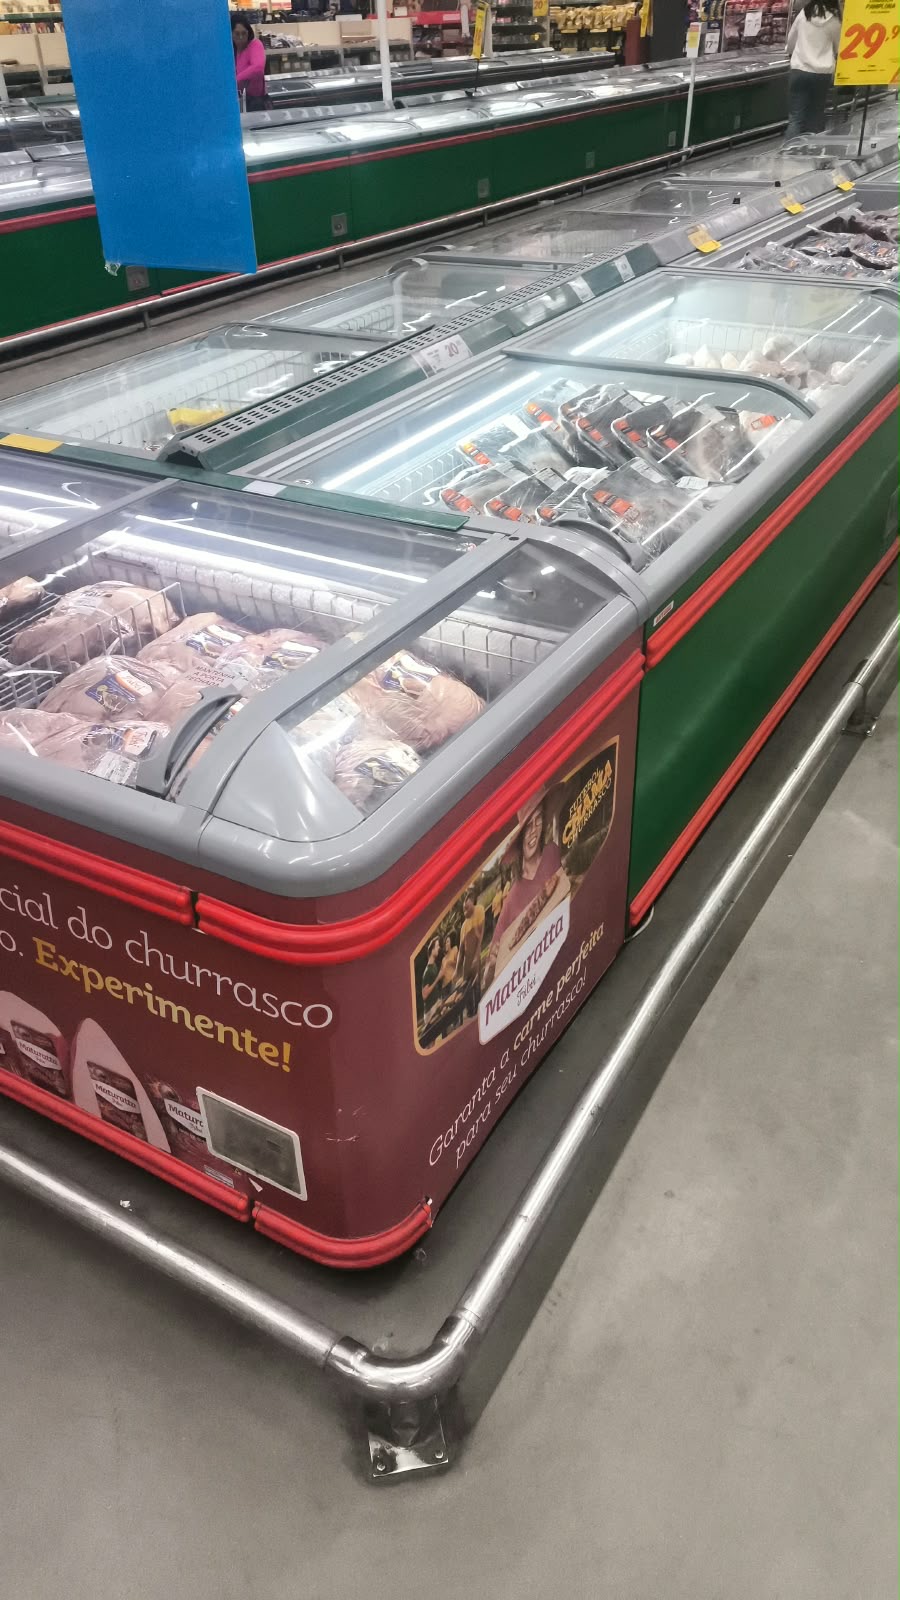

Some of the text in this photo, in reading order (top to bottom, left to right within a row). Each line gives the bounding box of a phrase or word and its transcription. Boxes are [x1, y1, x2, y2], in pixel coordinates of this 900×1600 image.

[194, 666, 235, 679] MANTENHA
[200, 673, 225, 683] PORTA
[32, 936, 292, 1073] Experimente!
[67, 906, 113, 950] do
[125, 930, 333, 1029] churrasco
[485, 915, 564, 1027] Maturatta
[429, 922, 605, 1166] Garanta a carne perfeita
[456, 966, 587, 1169] para seu churrasco!
